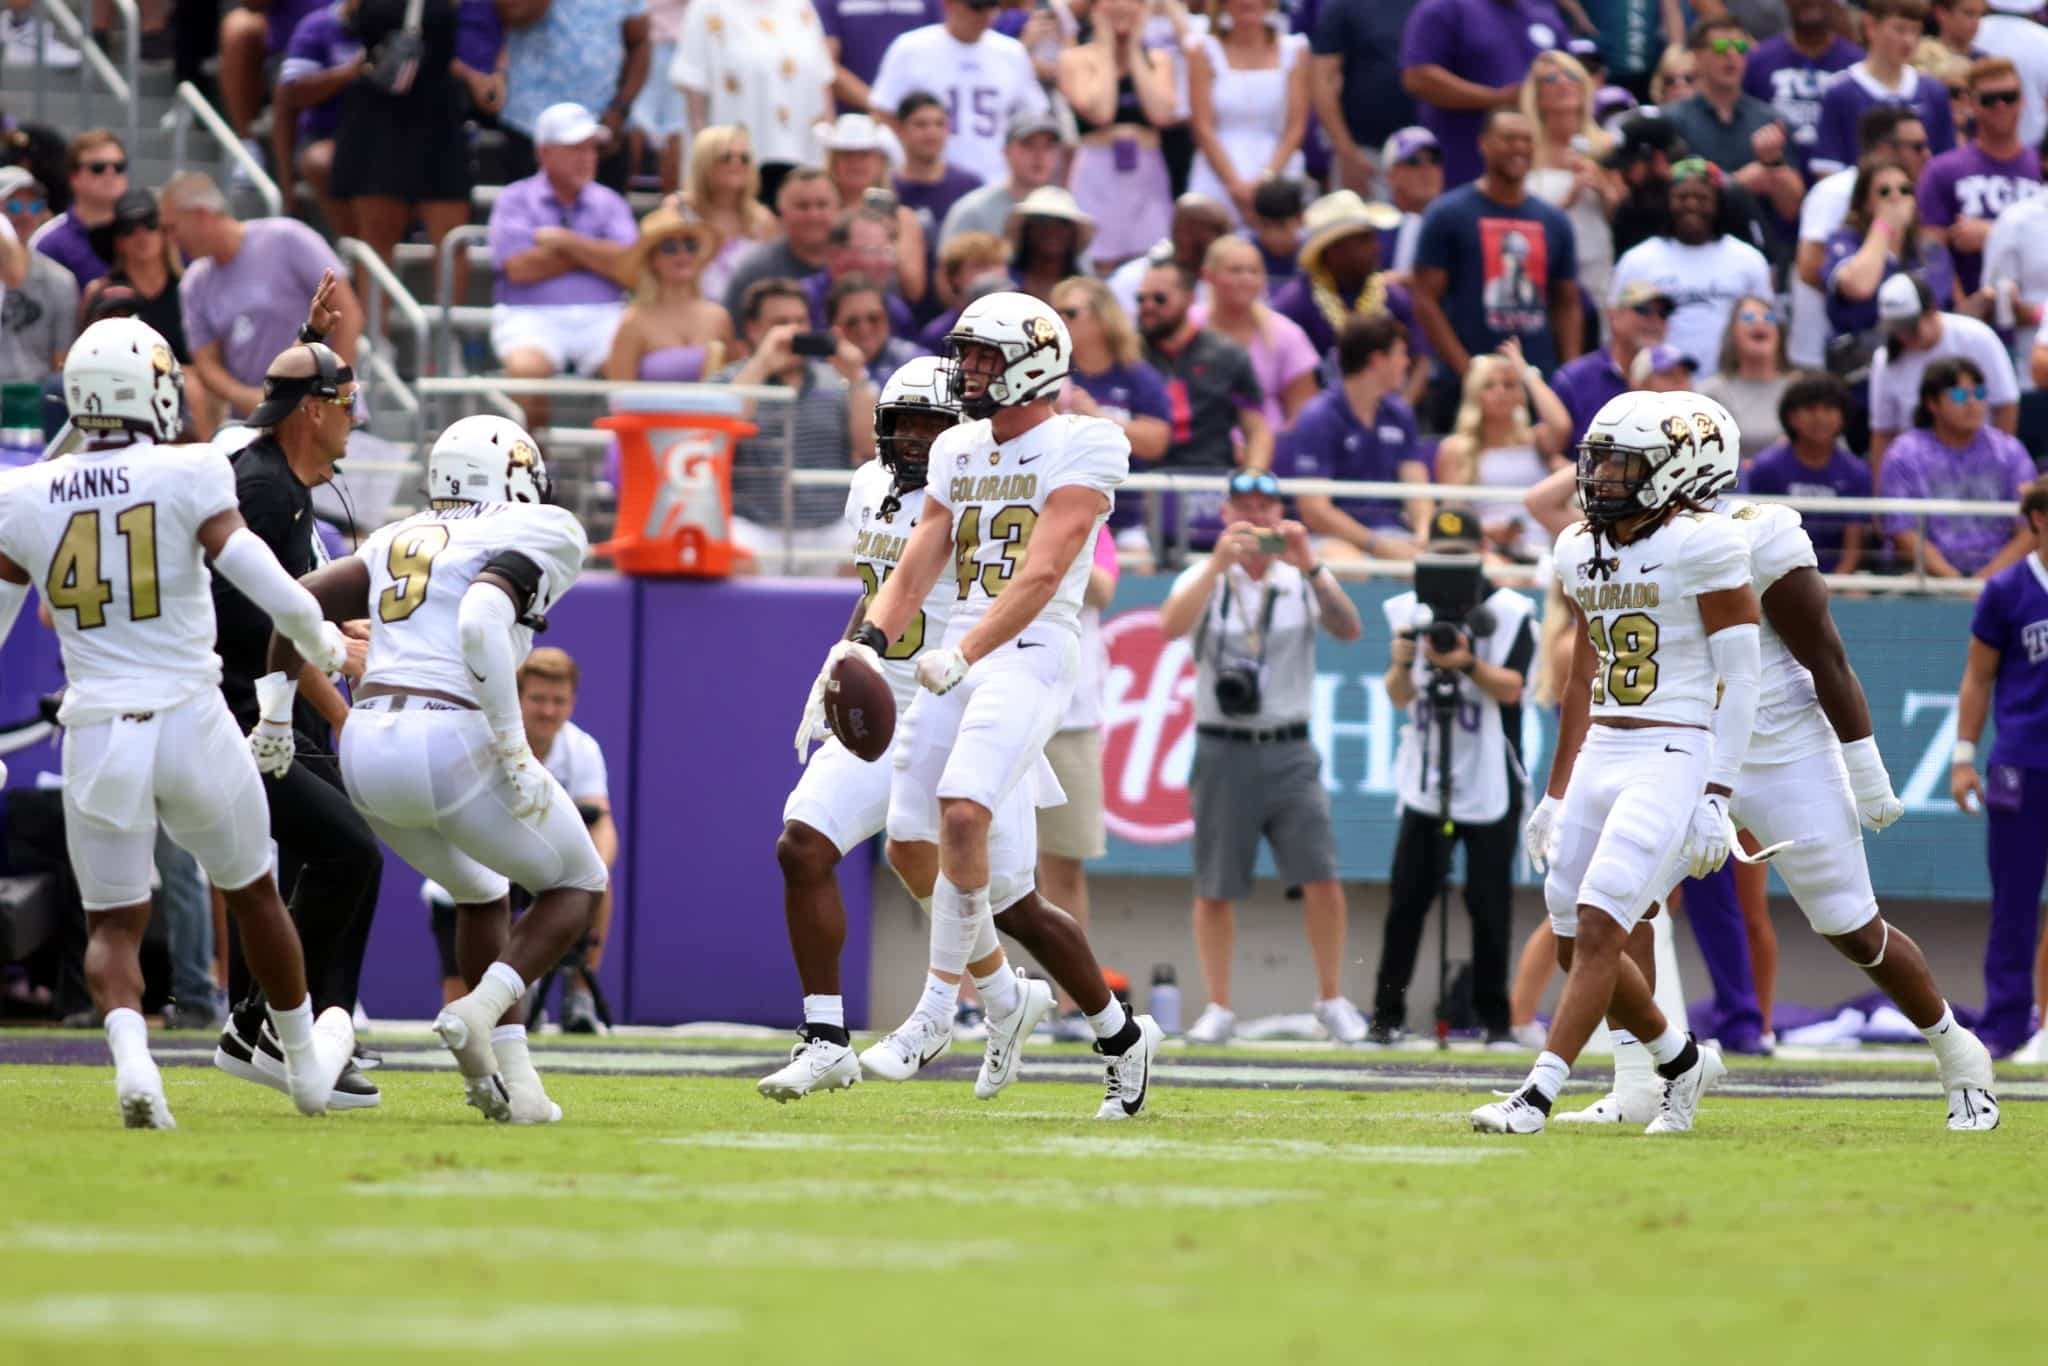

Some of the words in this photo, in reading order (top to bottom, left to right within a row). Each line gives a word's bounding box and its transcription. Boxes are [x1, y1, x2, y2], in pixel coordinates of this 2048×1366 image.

[944, 86, 1000, 137] 15
[50, 467, 130, 504] MANNS
[450, 480, 460, 496] 9
[667, 438, 714, 489] G
[950, 473, 1037, 502] COLORADO
[46, 501, 161, 630] 41
[378, 524, 450, 624] 9
[955, 504, 1040, 601] 43
[1576, 582, 1660, 612] COLORADO
[1588, 612, 1660, 706] 18
